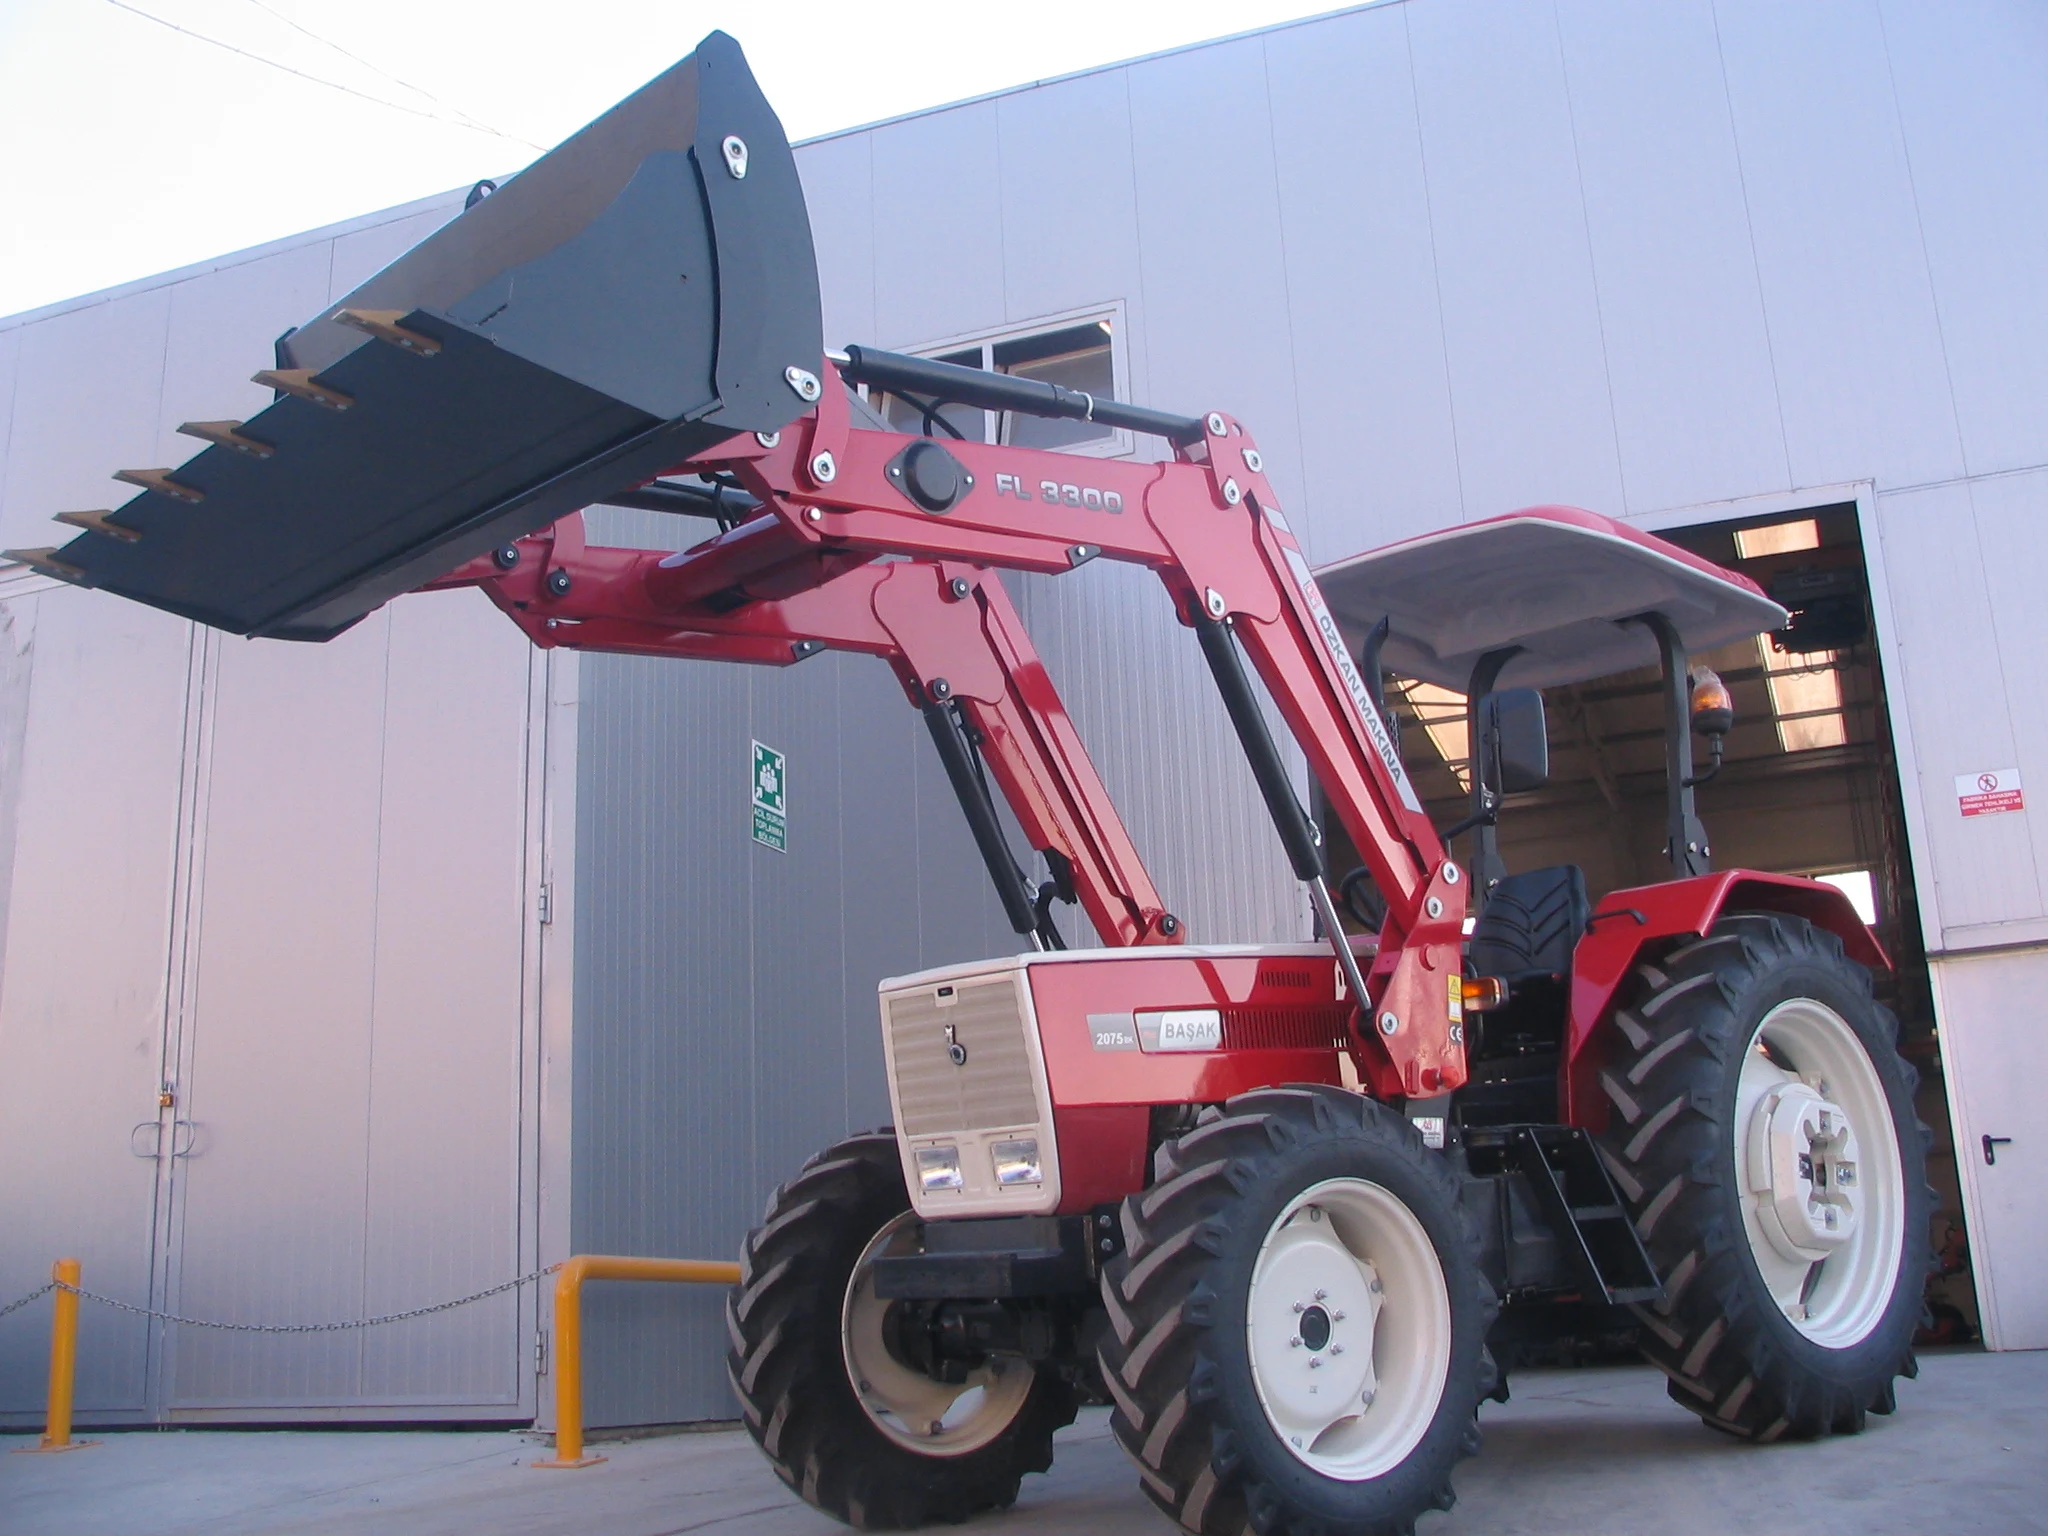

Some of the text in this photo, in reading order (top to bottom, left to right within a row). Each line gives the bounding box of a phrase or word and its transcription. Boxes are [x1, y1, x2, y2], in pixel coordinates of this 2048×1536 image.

[995, 473, 1124, 515] FL 3300
[1319, 614, 1360, 694] ÖZKAN
[1096, 1032, 1124, 1045] 2075
[1165, 1022, 1216, 1042] BAŞAK
